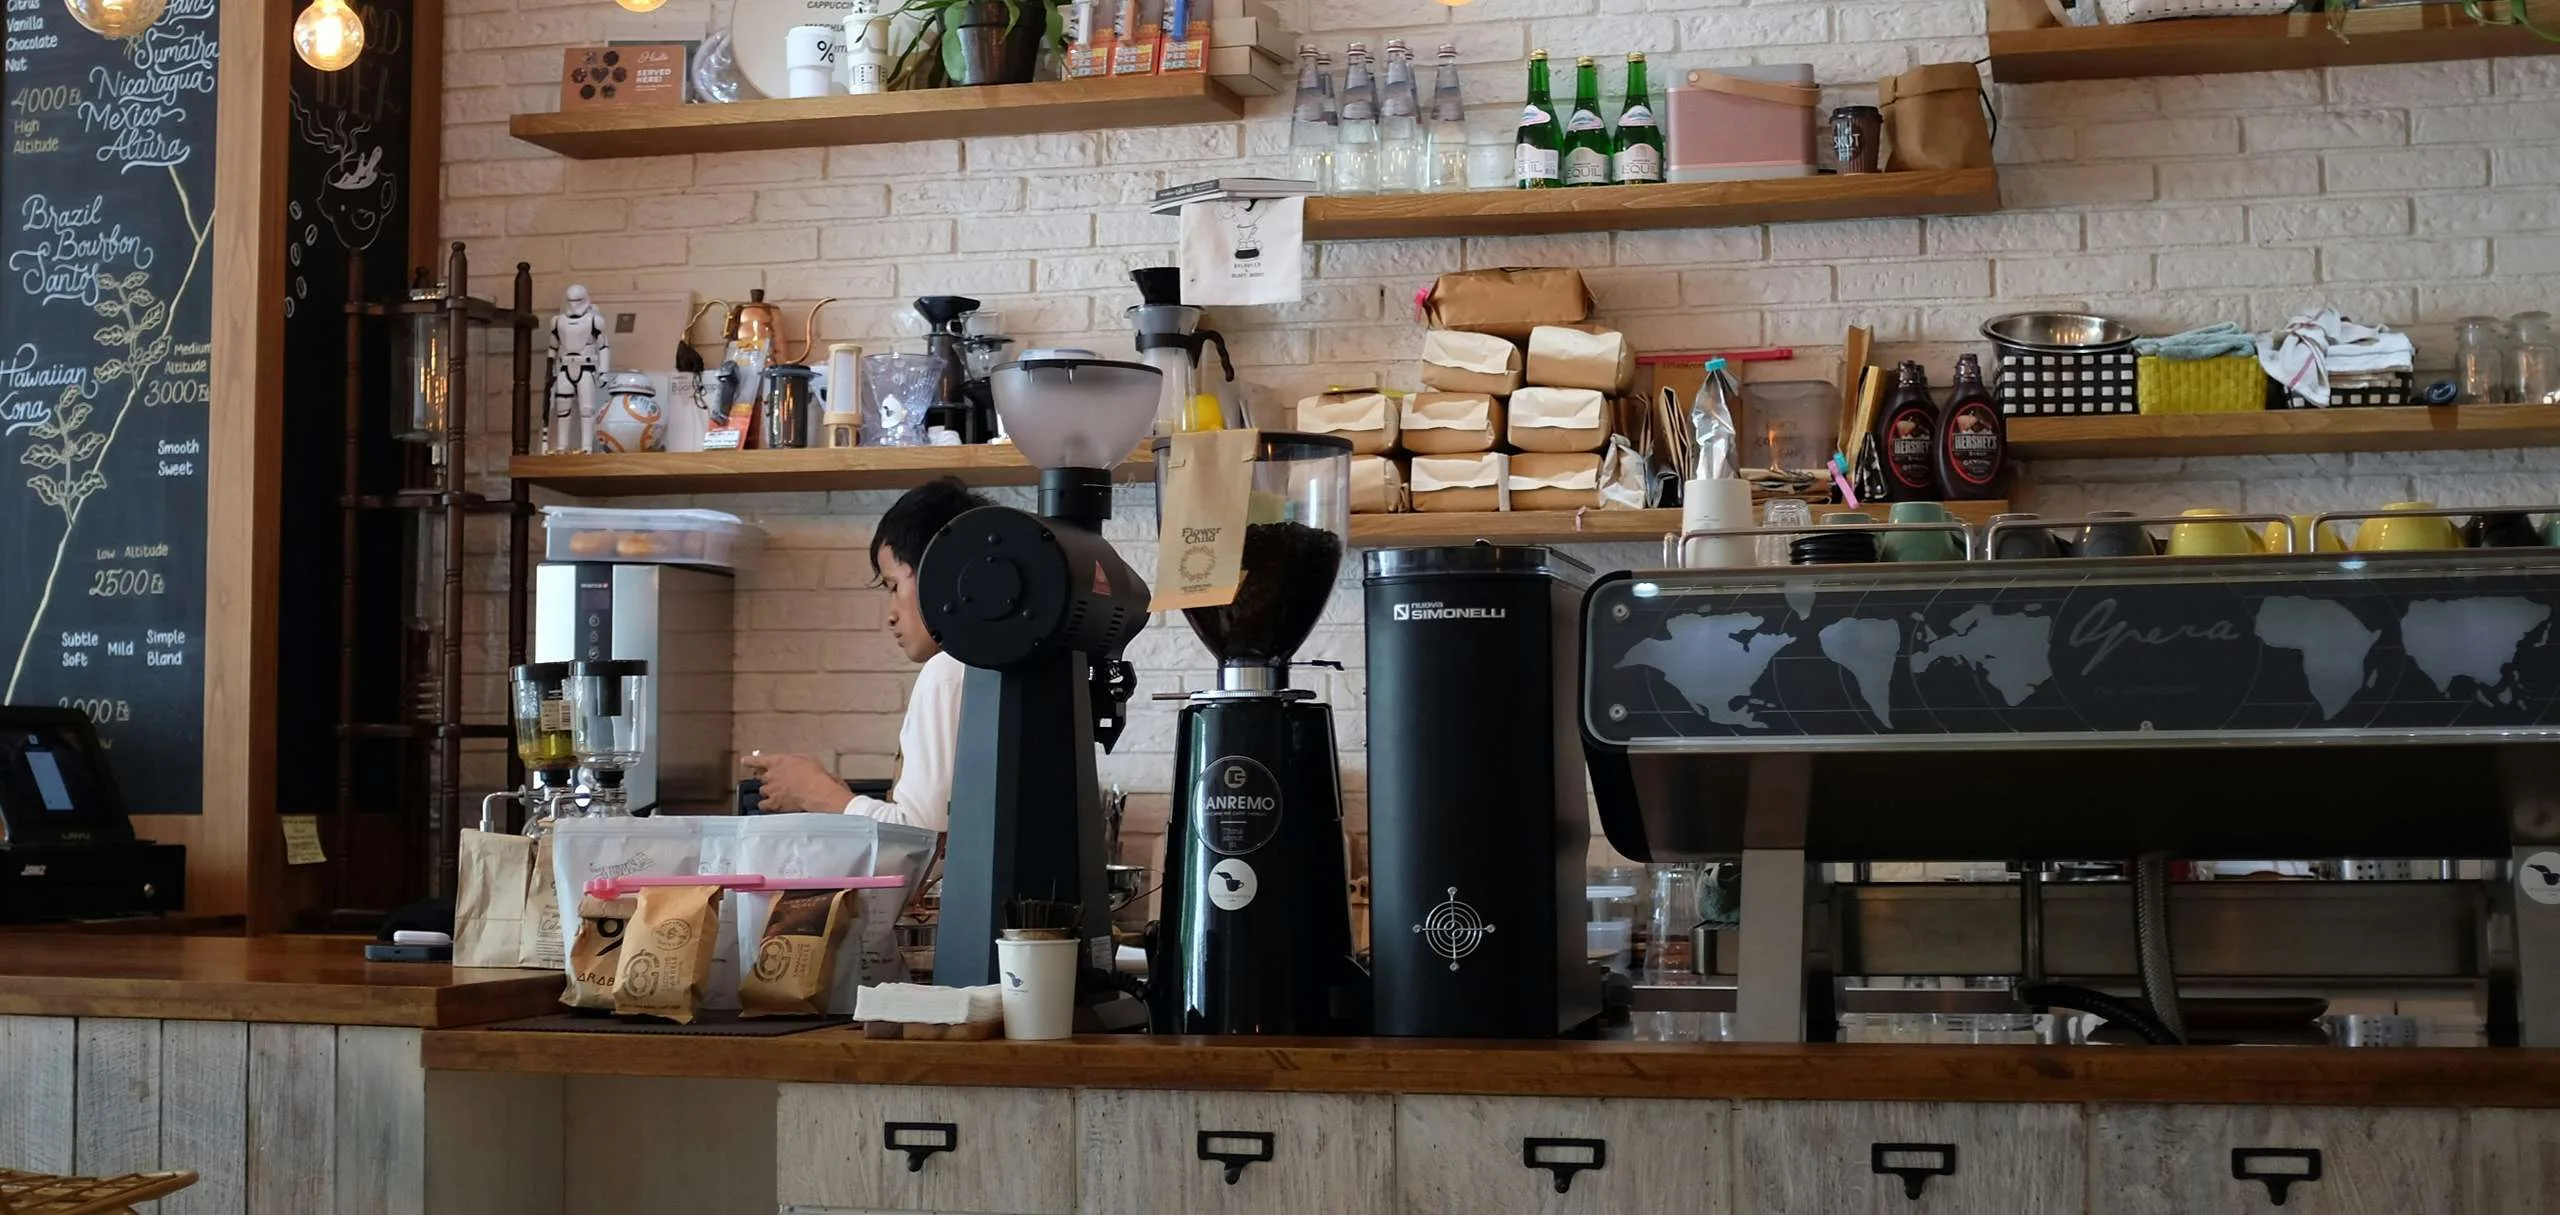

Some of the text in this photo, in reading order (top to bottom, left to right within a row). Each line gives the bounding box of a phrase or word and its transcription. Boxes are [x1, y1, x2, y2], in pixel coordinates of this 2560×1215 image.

[7, 16, 44, 33] Vanilla
[6, 34, 58, 51] Chocolate
[134, 25, 220, 74] Sumatra
[5, 57, 28, 72] Nut
[89, 66, 214, 105] Nicaragua
[11, 85, 67, 115] 4000
[78, 101, 185, 133] Mexico
[14, 119, 40, 137] High
[13, 137, 59, 154] Altitude
[97, 129, 190, 174] Altura
[22, 194, 103, 235] Brazil
[52, 224, 153, 269] Bourbon
[9, 241, 99, 306] Santos
[174, 343, 211, 355] Medium
[0, 343, 99, 399] Hawaiian
[164, 360, 207, 374] Altitude
[144, 379, 197, 407] 3000
[158, 438, 200, 455] Smooth
[1894, 440, 1931, 454] HERSHEY
[158, 460, 193, 476] Sweet
[1182, 527, 1222, 537] Flower
[1185, 534, 1216, 544] Child
[96, 542, 169, 560] Low Altitude
[89, 569, 149, 597] 2500
[1411, 608, 1505, 620] SIMONELLI
[61, 632, 99, 647] Subtle
[146, 629, 186, 648] Simple
[2069, 598, 2242, 676] Opera
[107, 641, 134, 656] Mild
[62, 652, 88, 667] Soft
[147, 651, 182, 666] Bland
[577, 972, 615, 987] ARAB
